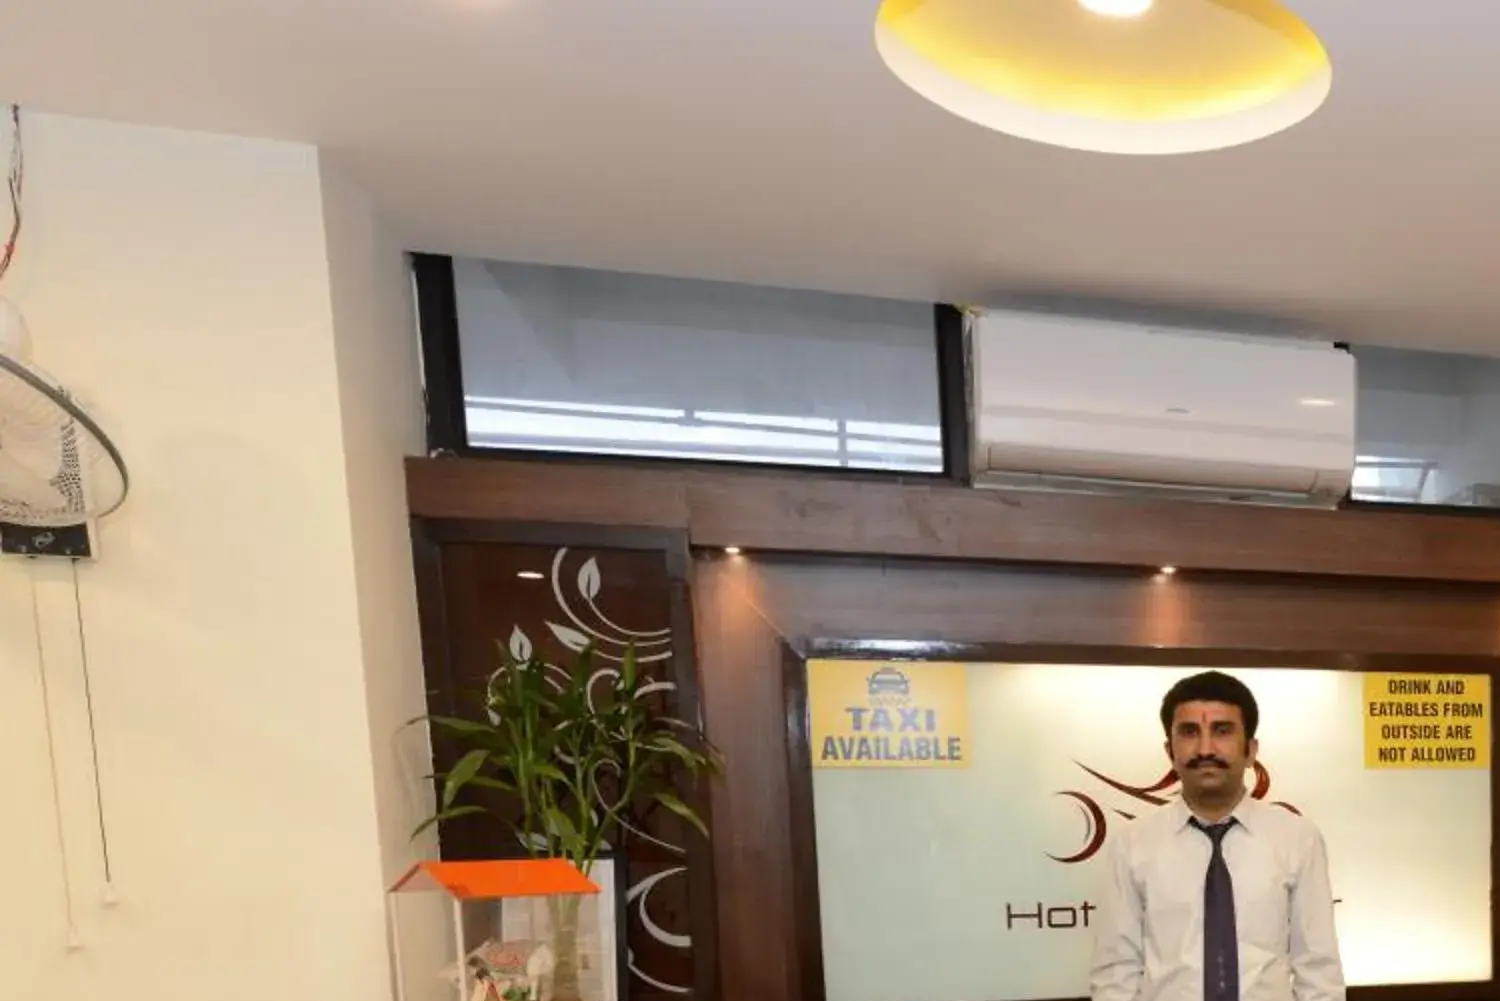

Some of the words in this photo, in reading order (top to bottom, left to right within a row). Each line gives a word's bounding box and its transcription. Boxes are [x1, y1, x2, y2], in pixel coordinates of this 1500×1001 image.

[1388, 679, 1431, 695] DRINK
[1436, 679, 1465, 695] AND
[1369, 701, 1439, 717] EATABLES
[1443, 702, 1483, 718] FROM
[845, 706, 936, 732] TAXI
[1381, 723, 1440, 740] OUTSIDE
[1446, 725, 1473, 740] ARE
[821, 735, 962, 761] AVAILABLE
[1378, 746, 1406, 762] NOT
[1411, 746, 1476, 762] ALLOWED
[1006, 901, 1097, 930] Hot
